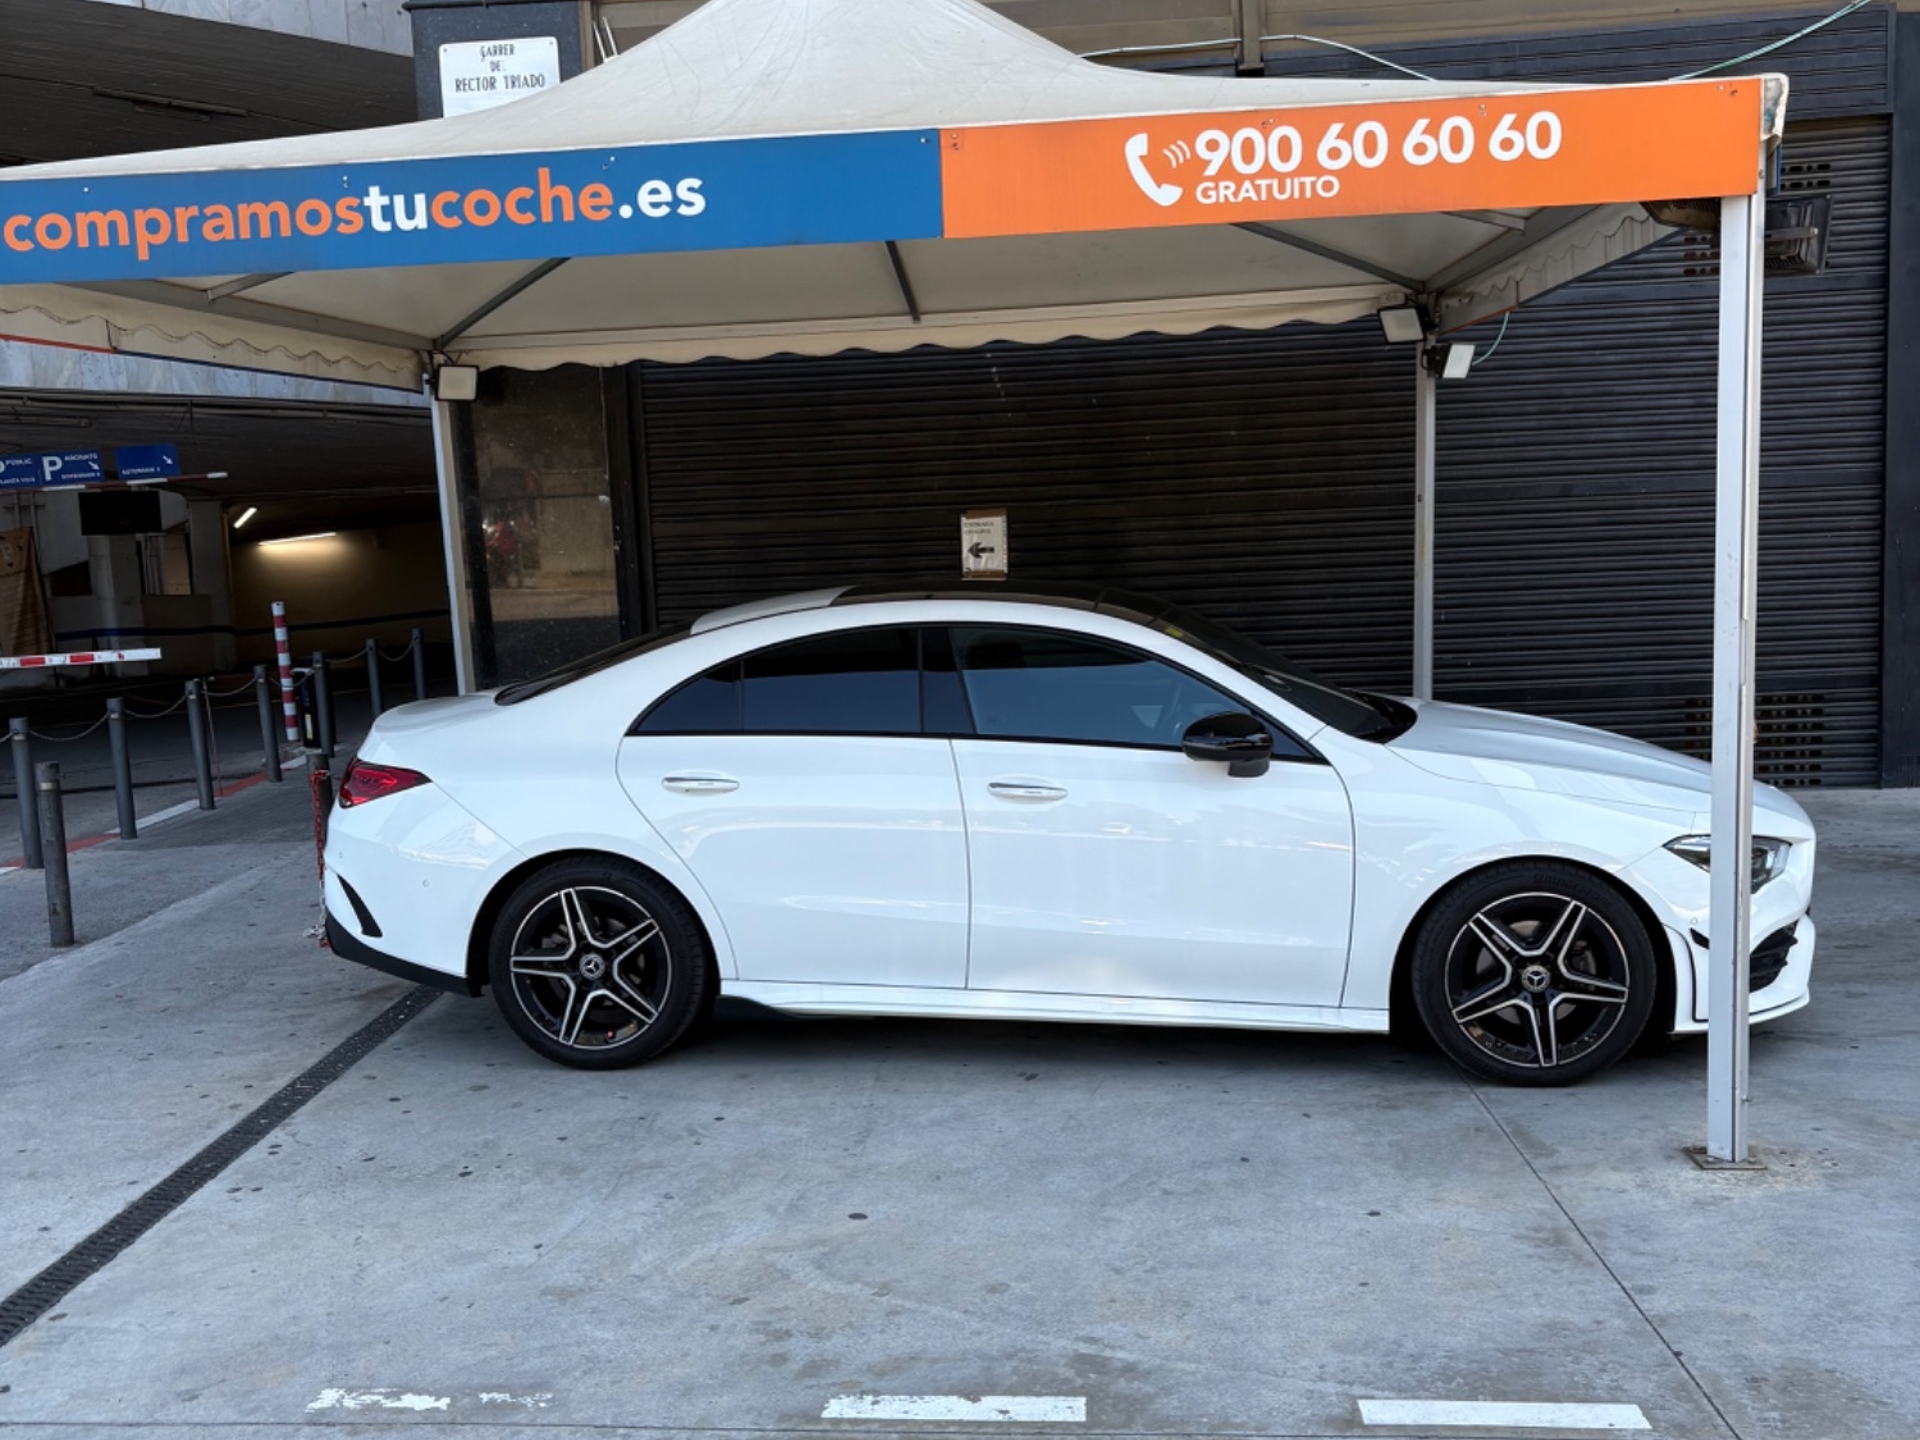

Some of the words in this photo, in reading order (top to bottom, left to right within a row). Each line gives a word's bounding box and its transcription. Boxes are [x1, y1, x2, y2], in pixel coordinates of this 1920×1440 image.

[455, 76, 497, 93] RECTOR
[1196, 126, 1303, 176] 900
[1317, 121, 1389, 170] 60
[1403, 116, 1475, 166] 60
[1489, 111, 1562, 161] 60
[1196, 174, 1340, 205] GRATUITO
[3, 167, 706, 260] compramostucoche.es
[41, 456, 63, 482] P
